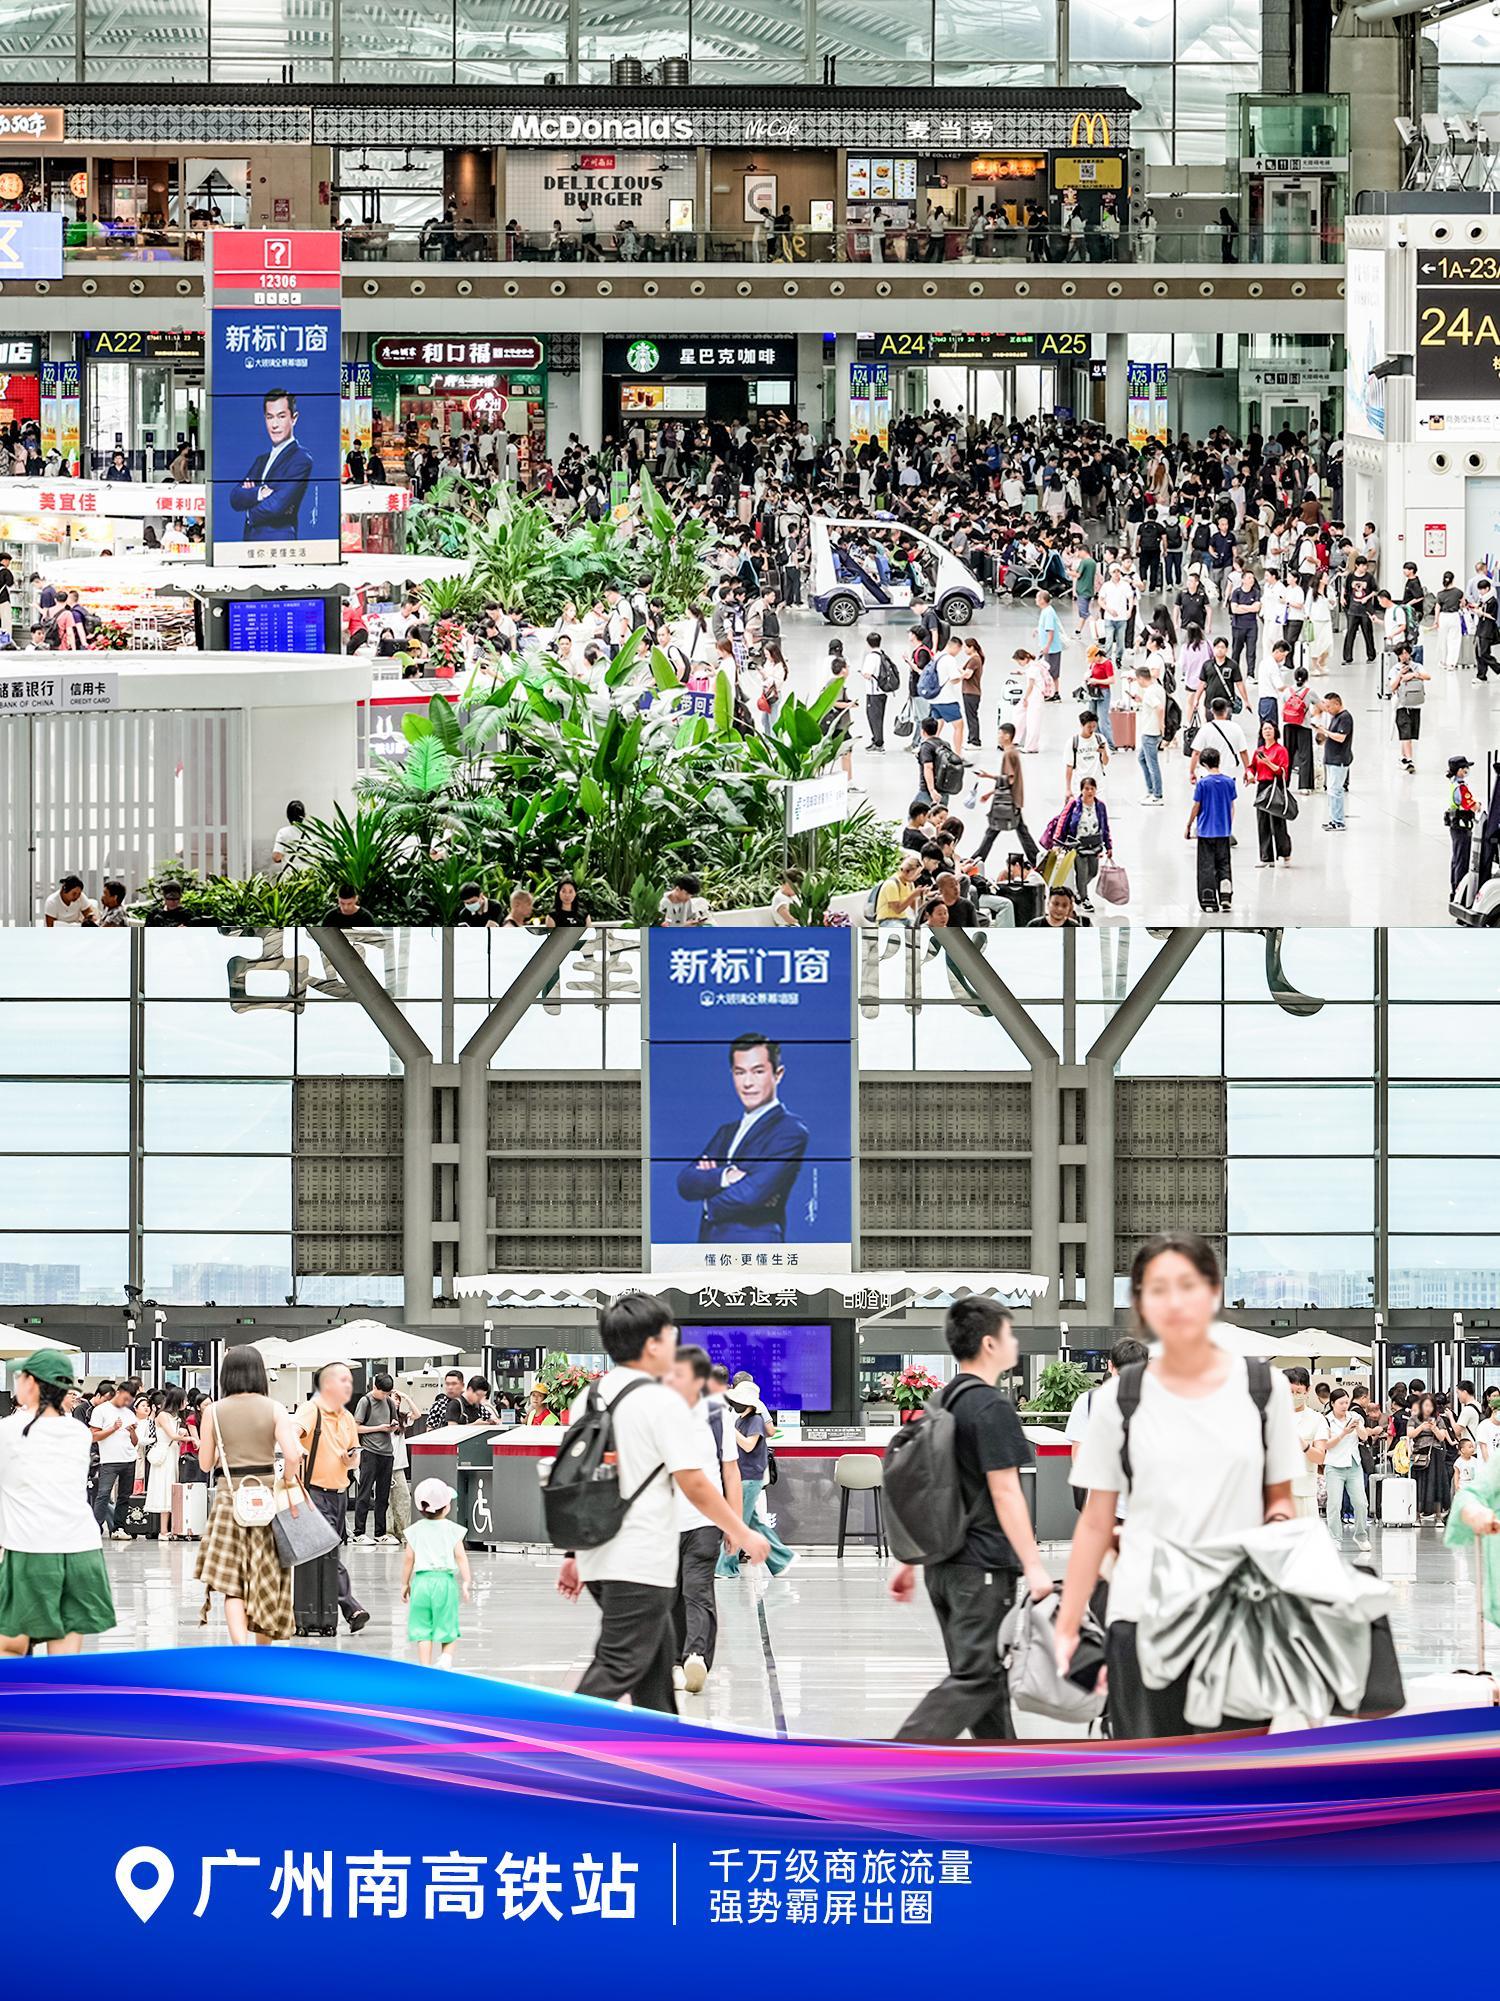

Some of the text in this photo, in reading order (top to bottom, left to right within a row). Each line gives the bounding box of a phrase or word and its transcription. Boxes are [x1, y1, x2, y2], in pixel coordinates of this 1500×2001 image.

[511, 115, 694, 140] McDonald's
[906, 120, 994, 140] 麦当劳
[543, 175, 664, 191] DELICIOUS
[563, 192, 643, 207] BURGER
[1437, 257, 1500, 279] 1A-23
[259, 274, 298, 288] 12306
[1420, 307, 1500, 346] 24A
[95, 332, 143, 353] A22
[225, 324, 329, 352] 新标门窗
[880, 334, 926, 355] A24
[1040, 333, 1088, 354] A25
[422, 342, 492, 364] 利口福
[679, 348, 776, 365] 星巴克咖啡
[63, 367, 78, 382] A22
[357, 368, 371, 383] A23
[852, 369, 868, 383] A24
[1131, 369, 1148, 383] A25
[39, 492, 96, 511] 美宜佳
[70, 681, 106, 696] 信用卡
[19, 700, 29, 708] OF
[31, 699, 54, 707] CHINA
[669, 947, 830, 984] 新标门窗
[705, 1253, 799, 1267] 懂你·更懂生活
